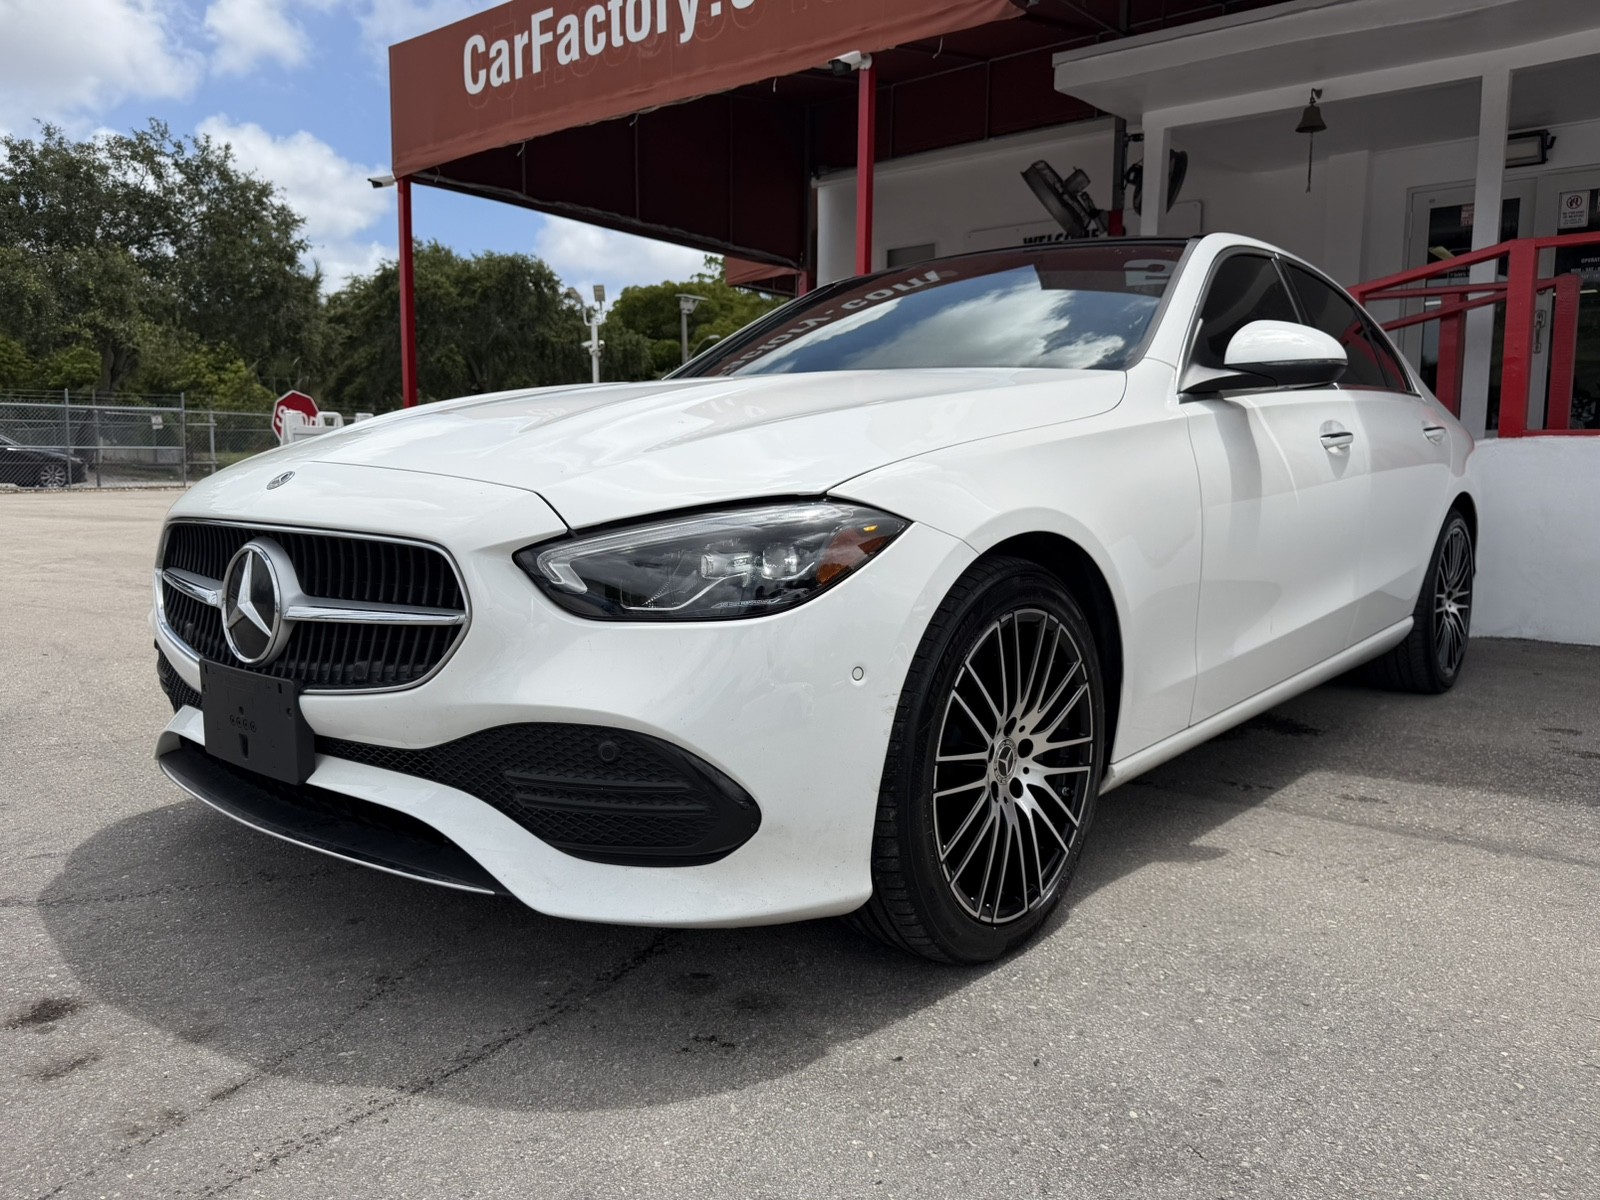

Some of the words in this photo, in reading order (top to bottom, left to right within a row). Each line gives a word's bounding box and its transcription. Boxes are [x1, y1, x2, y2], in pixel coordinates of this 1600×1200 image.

[463, 0, 755, 95] CarFactory.
[1023, 229, 1099, 244] WELCME
[275, 405, 318, 427] SP
